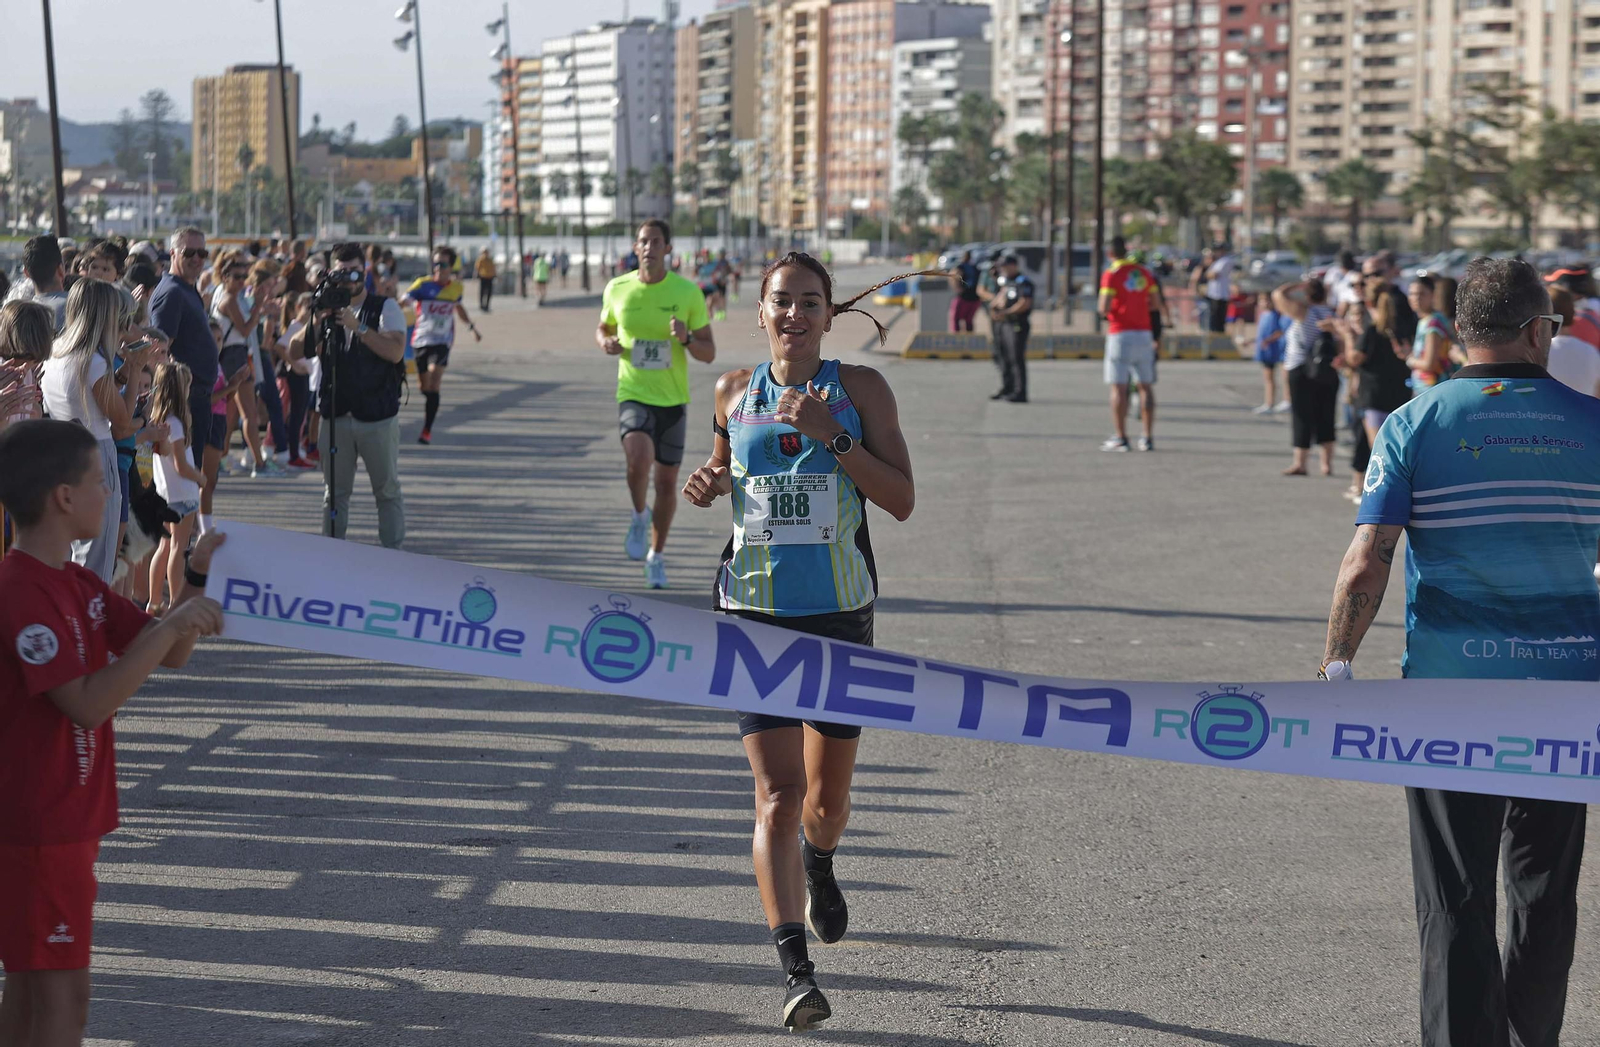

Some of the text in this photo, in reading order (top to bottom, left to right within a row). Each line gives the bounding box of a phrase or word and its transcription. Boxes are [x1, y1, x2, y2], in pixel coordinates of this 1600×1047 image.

[1484, 435, 1585, 450] Gabarras & Servicios
[753, 475, 792, 487] XXVI
[768, 493, 810, 518] 188
[768, 518, 812, 527] ESTEFANIA SOLIS
[1462, 638, 1501, 658] C.D.
[1506, 638, 1544, 660] TRAL
[223, 577, 526, 655] River2Time
[708, 621, 1132, 747] META
